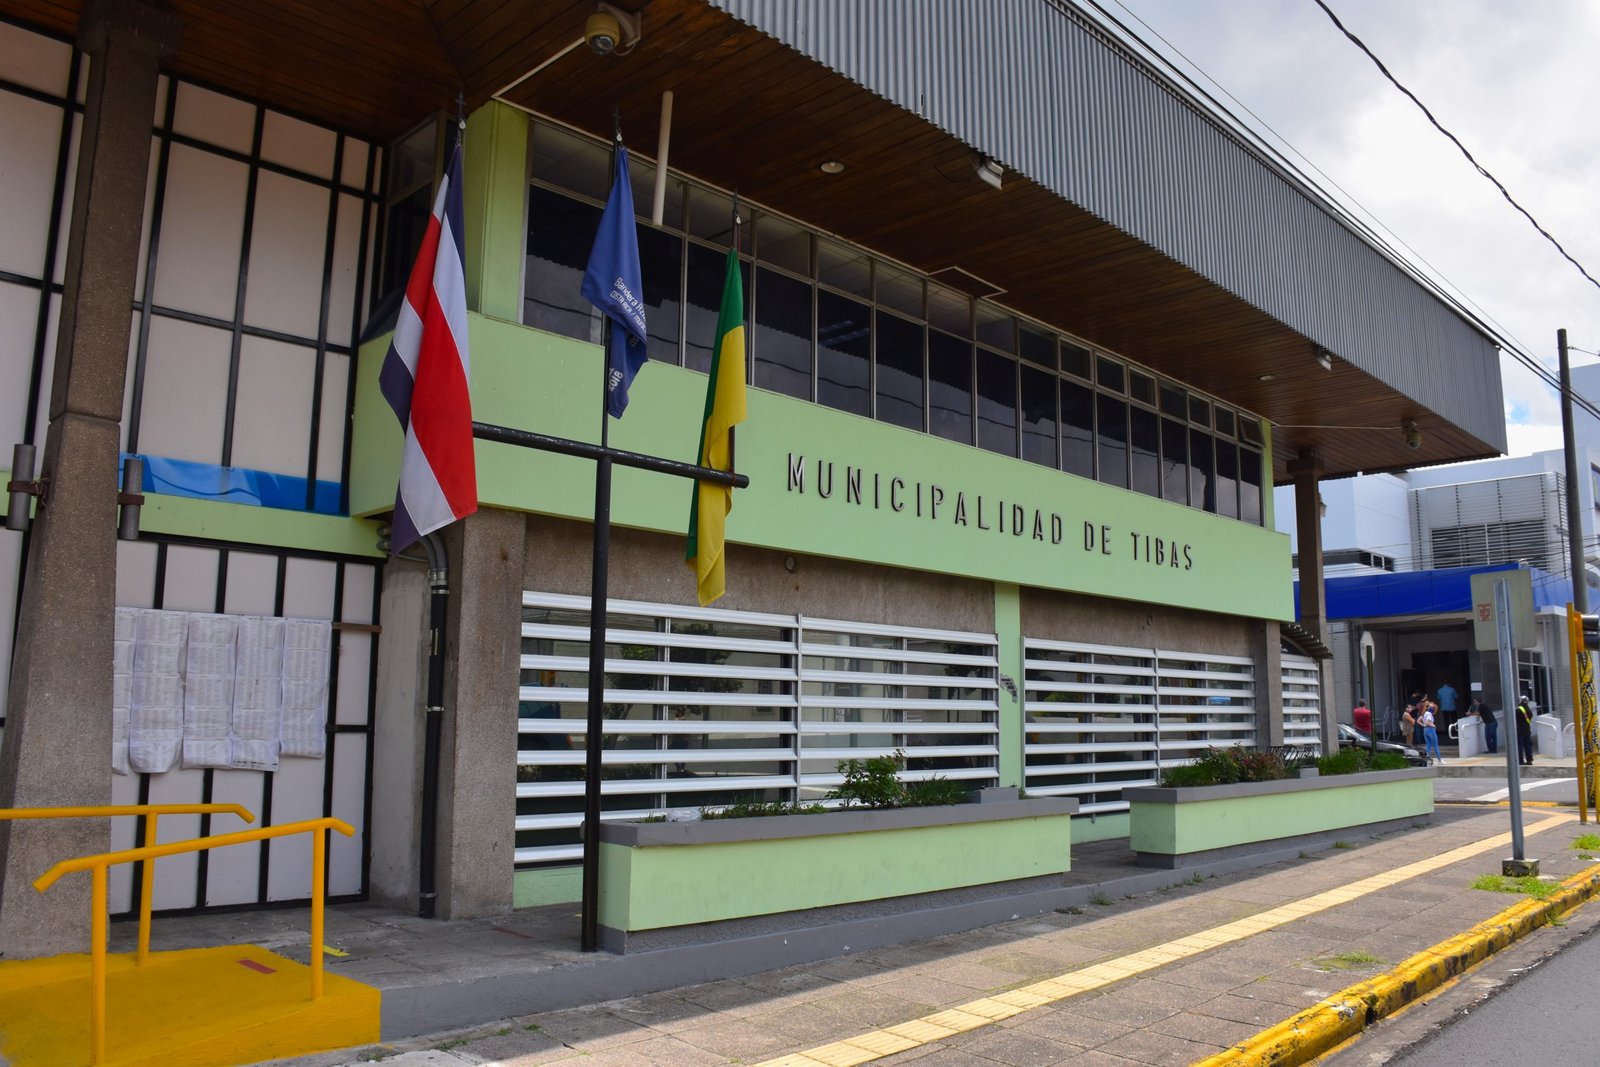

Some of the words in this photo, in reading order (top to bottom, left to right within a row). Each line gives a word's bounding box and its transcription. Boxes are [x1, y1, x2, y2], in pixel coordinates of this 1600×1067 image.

[614, 277, 638, 307] Bandera
[788, 453, 1063, 545] MUNICIPALIDAD
[1084, 521, 1112, 555] DE
[1131, 532, 1192, 570] TIBAS
